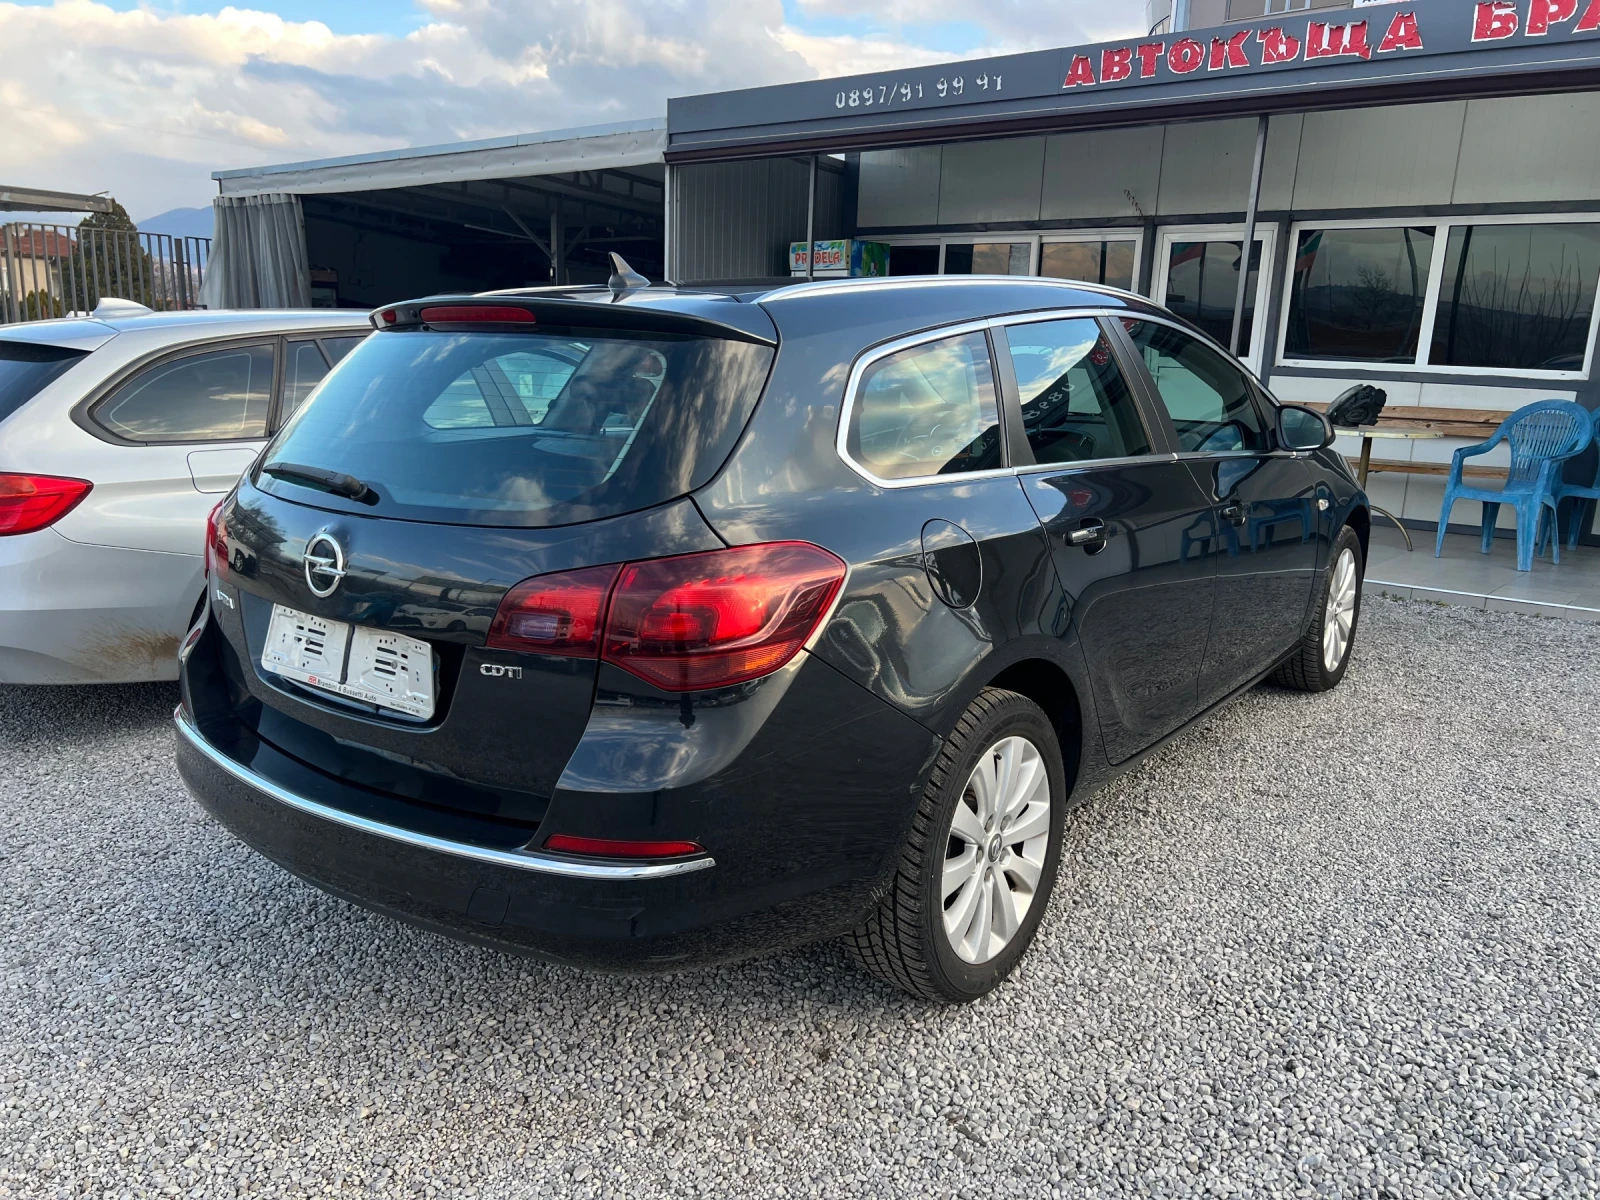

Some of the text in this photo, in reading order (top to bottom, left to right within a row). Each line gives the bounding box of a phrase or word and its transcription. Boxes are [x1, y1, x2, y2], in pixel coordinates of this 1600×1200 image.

[1062, 11, 1424, 89] АВТОКЪЩА
[936, 75, 965, 98] 99
[795, 251, 840, 264] PRDELA
[480, 663, 522, 679] CDTI
